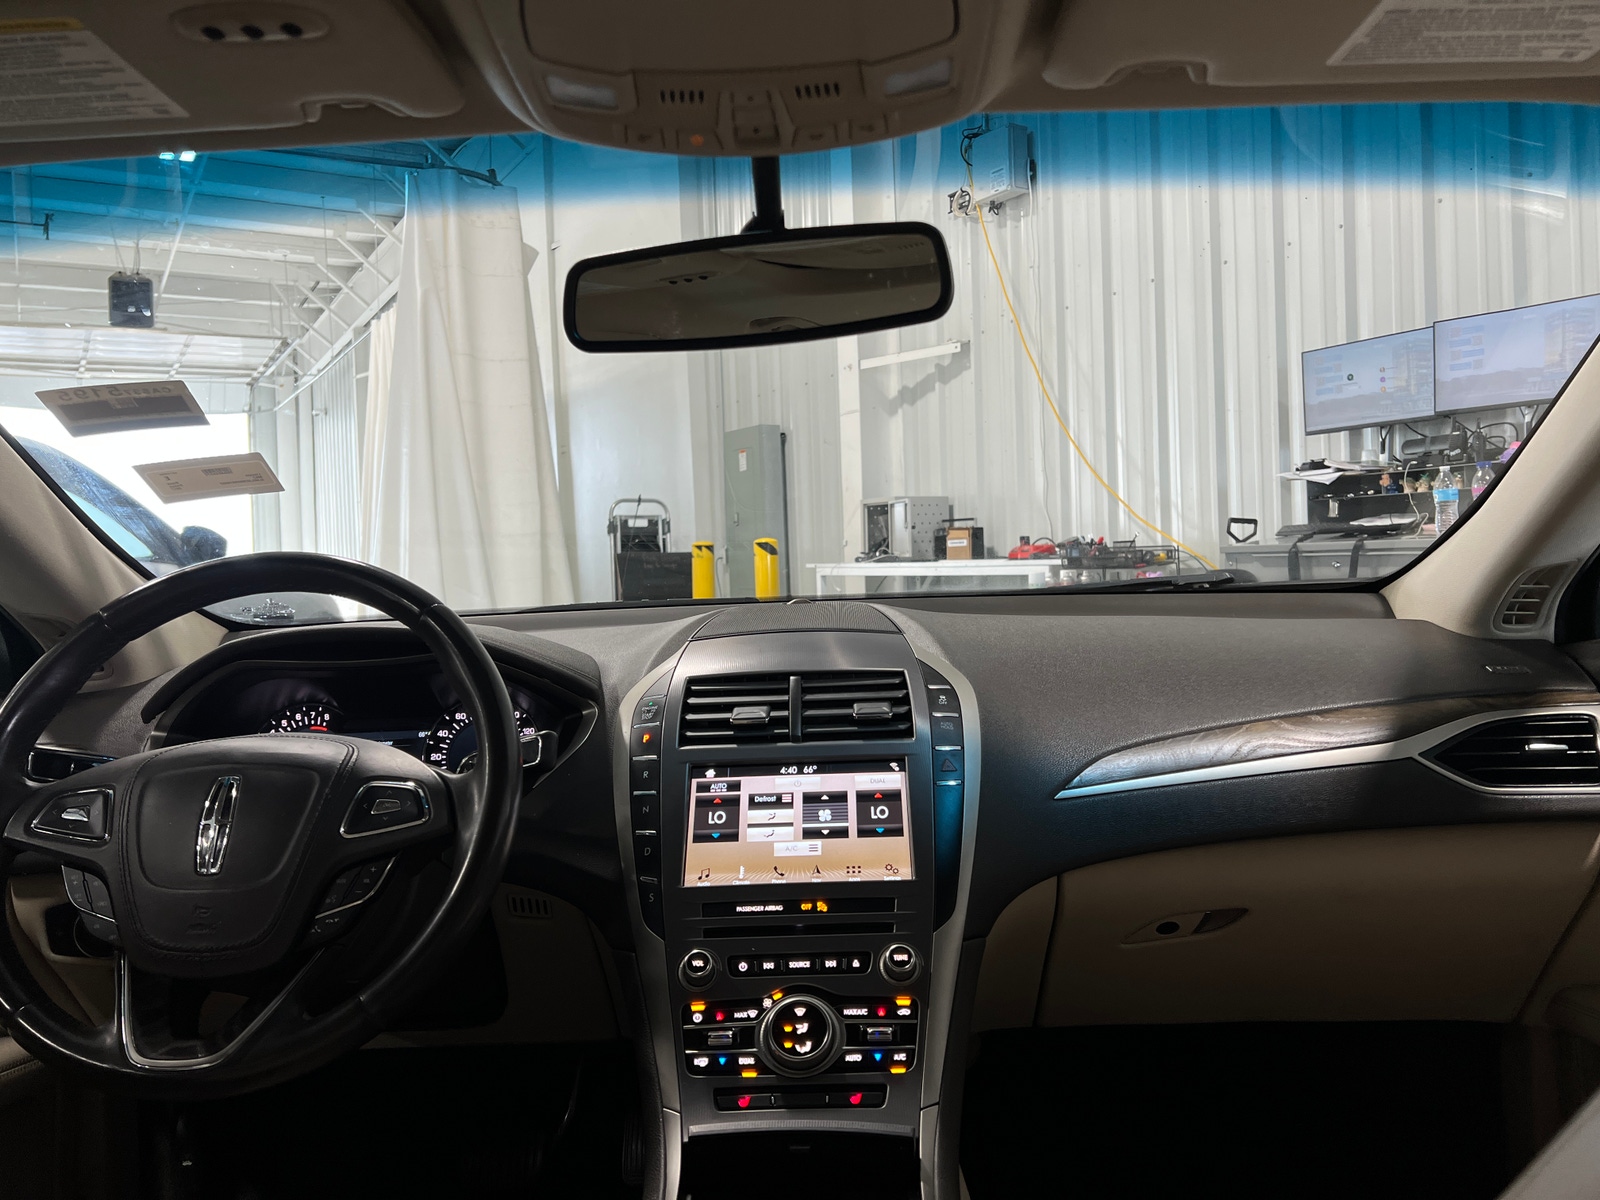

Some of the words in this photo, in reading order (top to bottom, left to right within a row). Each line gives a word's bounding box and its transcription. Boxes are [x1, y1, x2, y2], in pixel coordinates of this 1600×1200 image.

[643, 734, 650, 743] P
[780, 766, 798, 774] 4:40
[803, 765, 817, 773] 66°
[643, 770, 649, 779] R
[870, 805, 889, 819] LO
[708, 811, 726, 824] LO
[644, 847, 651, 856] D
[649, 893, 654, 902] S
[893, 1053, 906, 1061] A/C
